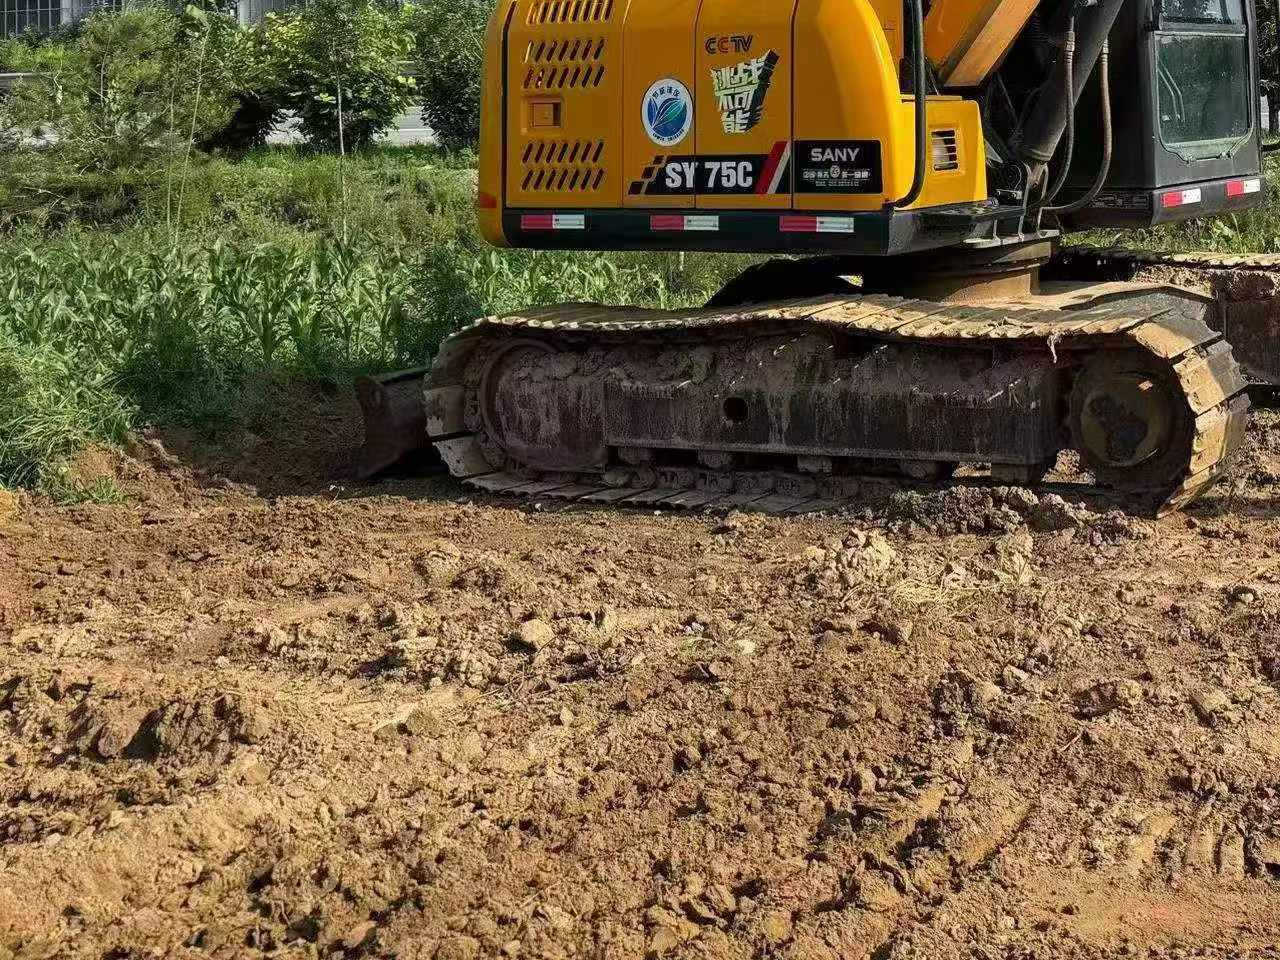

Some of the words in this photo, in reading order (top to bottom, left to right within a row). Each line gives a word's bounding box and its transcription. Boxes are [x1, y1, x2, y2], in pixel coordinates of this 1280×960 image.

[705, 35, 753, 54] CCTV
[810, 147, 860, 162] SANY
[665, 162, 699, 188] SY
[704, 161, 753, 188] 75C
